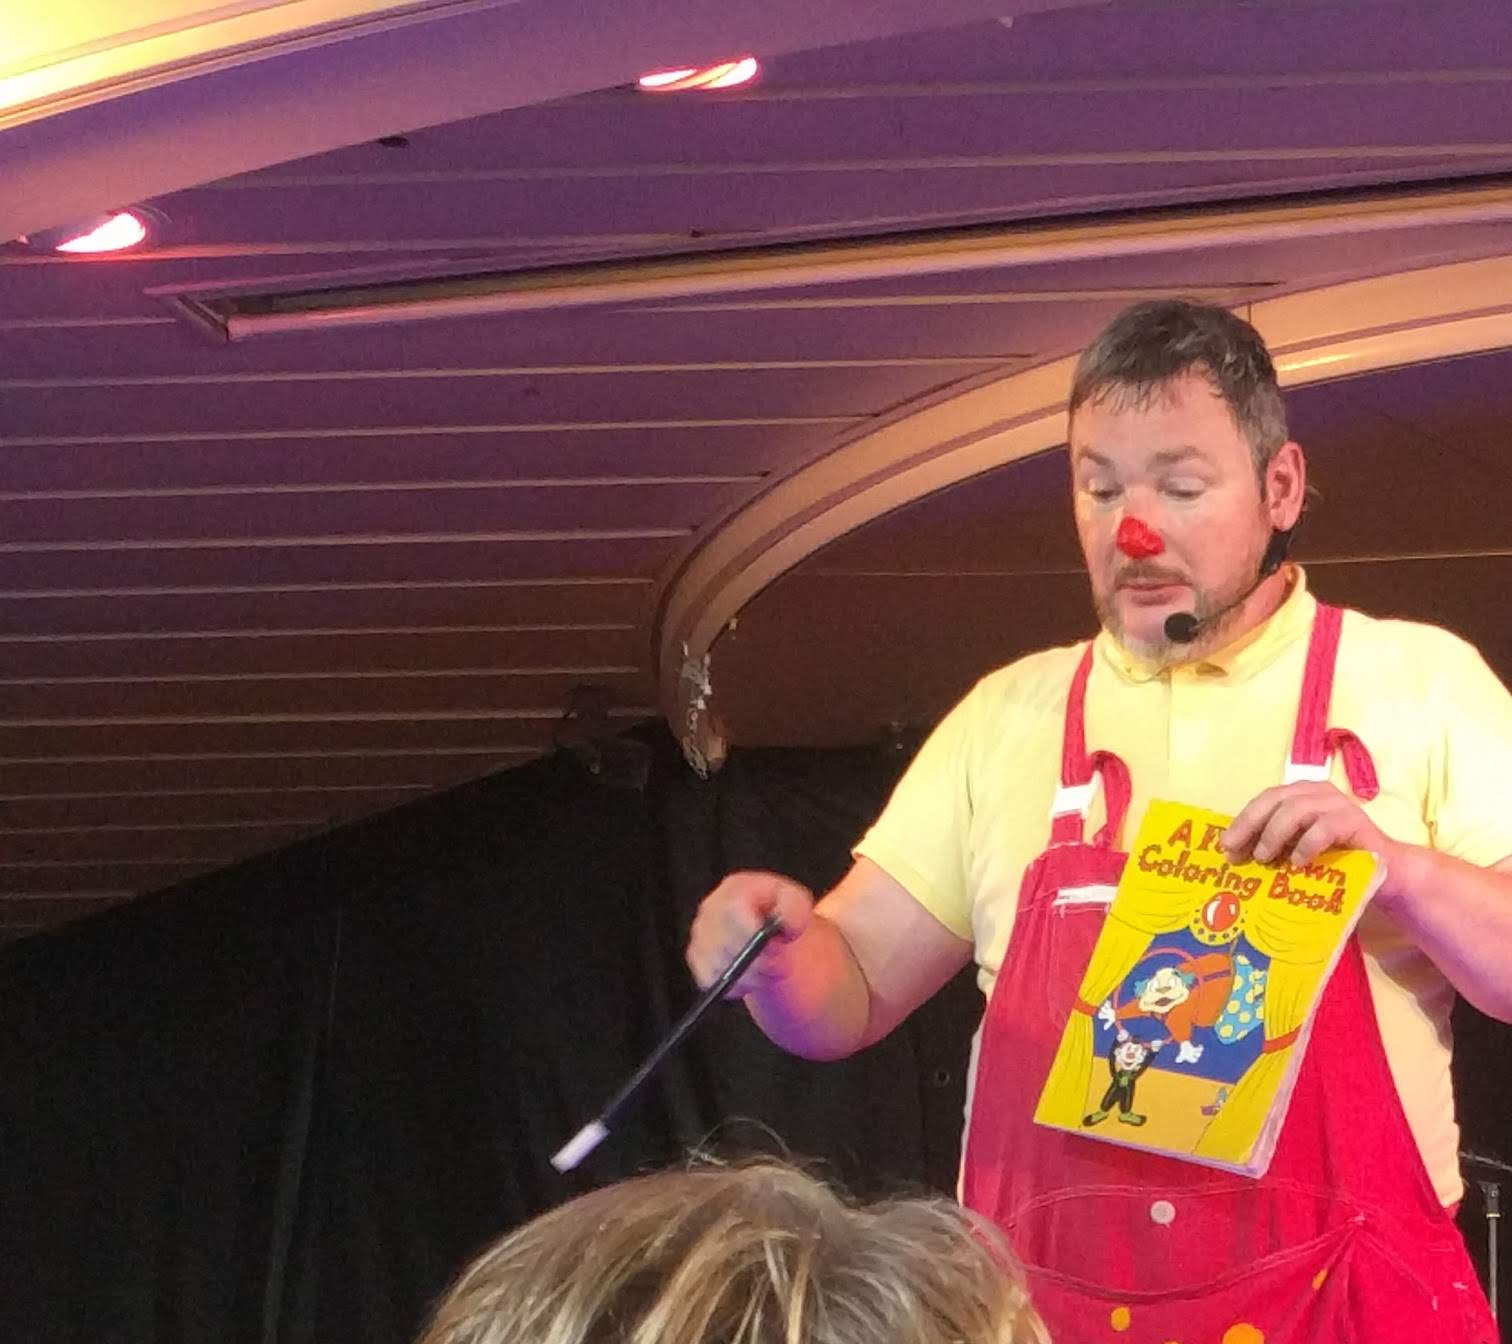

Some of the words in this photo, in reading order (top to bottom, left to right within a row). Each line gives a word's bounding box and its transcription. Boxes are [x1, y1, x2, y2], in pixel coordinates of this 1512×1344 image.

[1167, 818, 1192, 848] A
[1137, 843, 1263, 901] Coloring
[1267, 871, 1346, 915] Book
